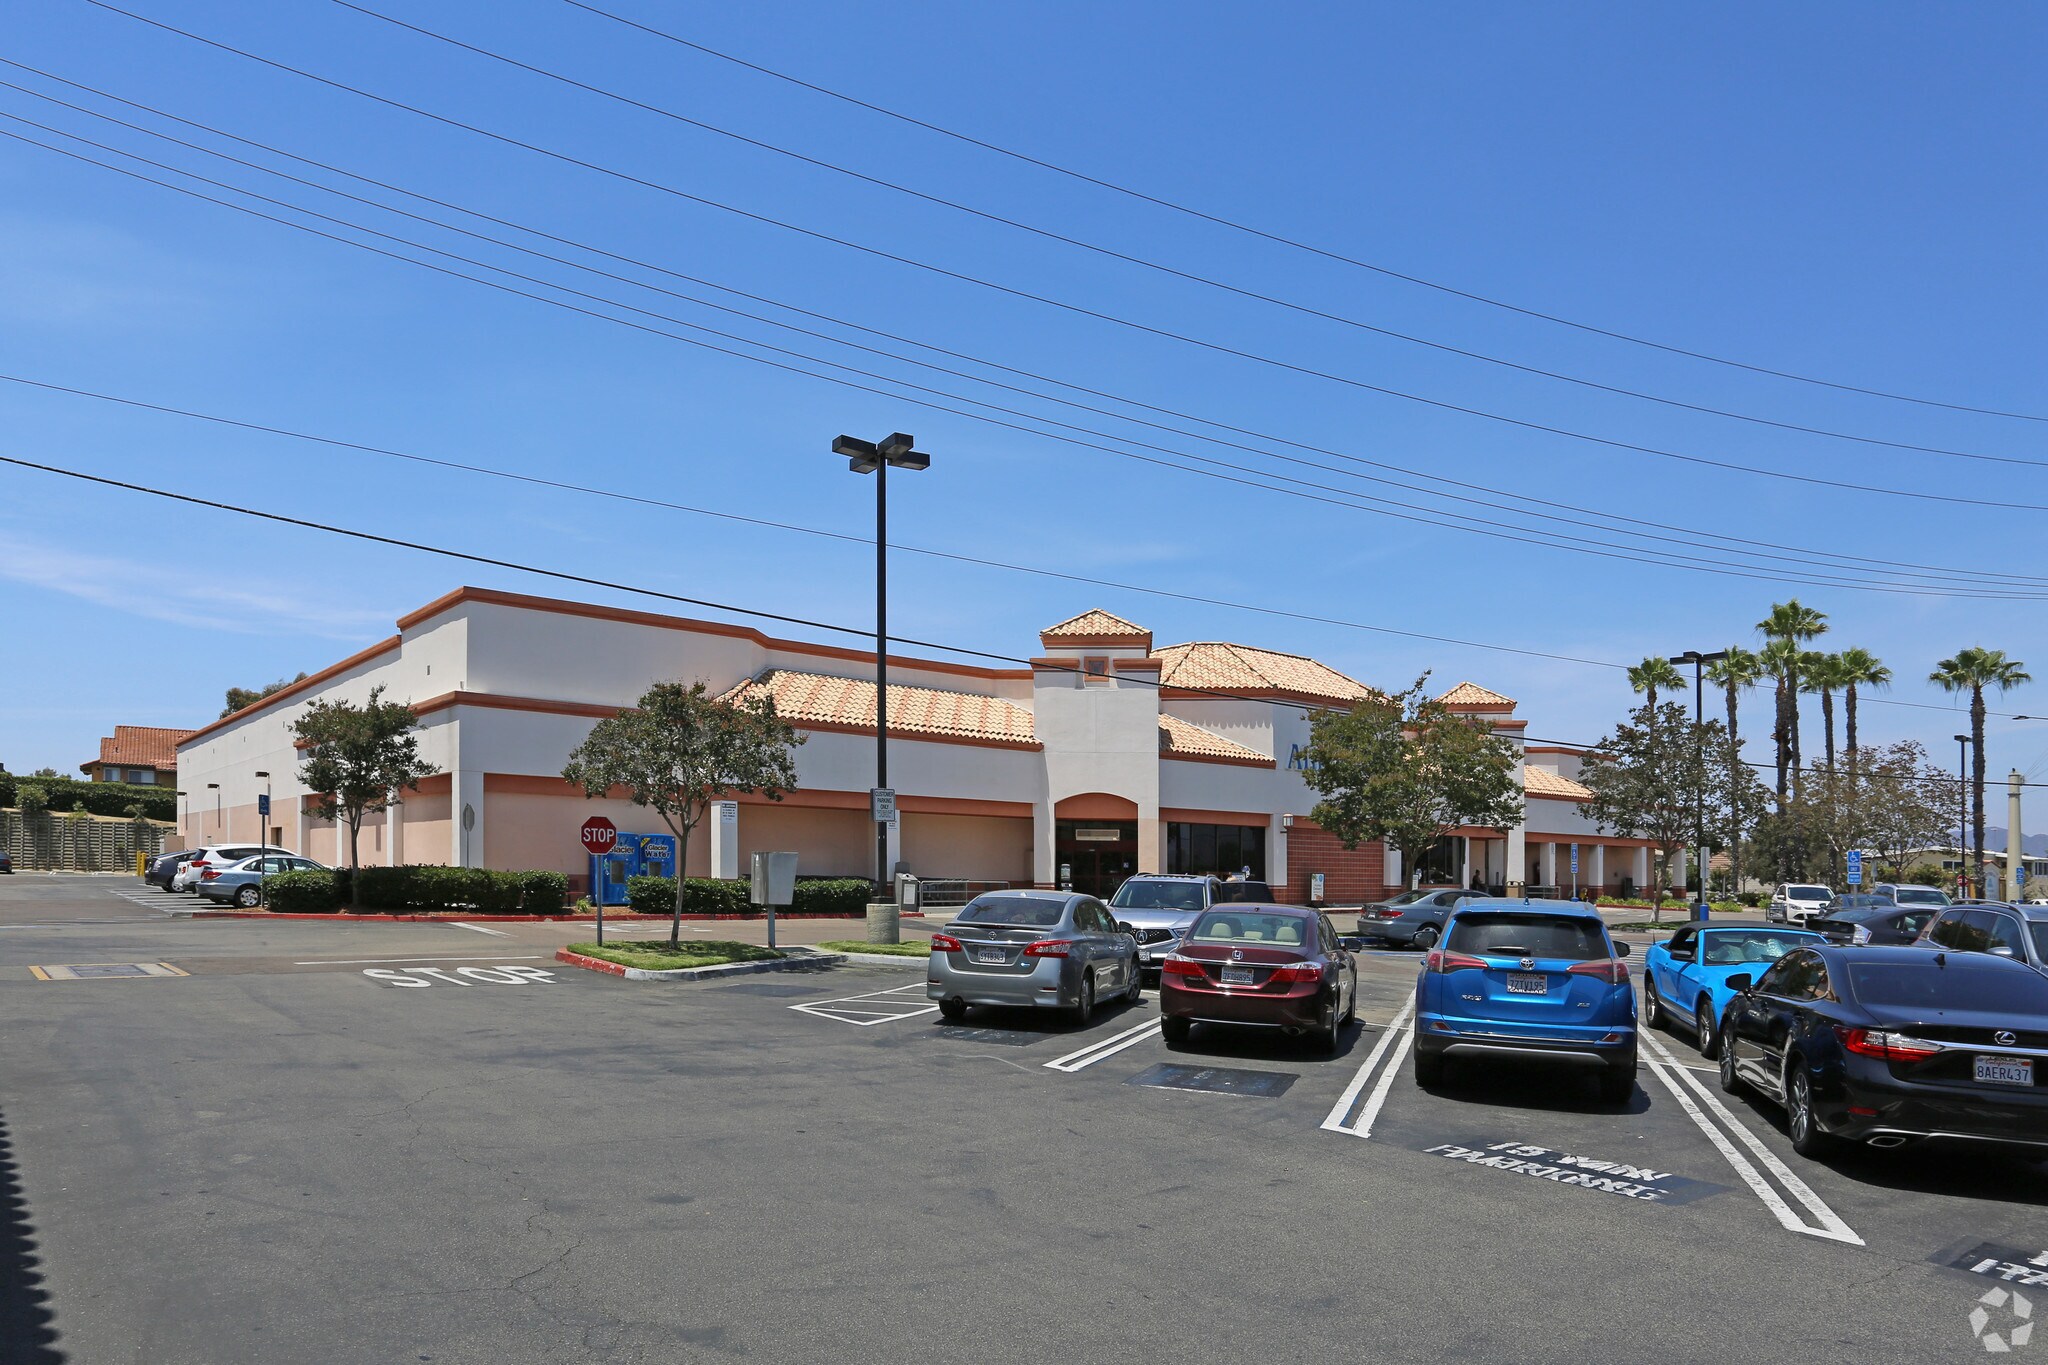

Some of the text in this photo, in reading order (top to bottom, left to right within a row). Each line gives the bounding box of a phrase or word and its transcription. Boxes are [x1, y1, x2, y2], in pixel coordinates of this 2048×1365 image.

[583, 828, 614, 842] STOP
[645, 850, 670, 858] Water
[363, 965, 557, 988] STOP
[1977, 1065, 2029, 1082] 8AER437
